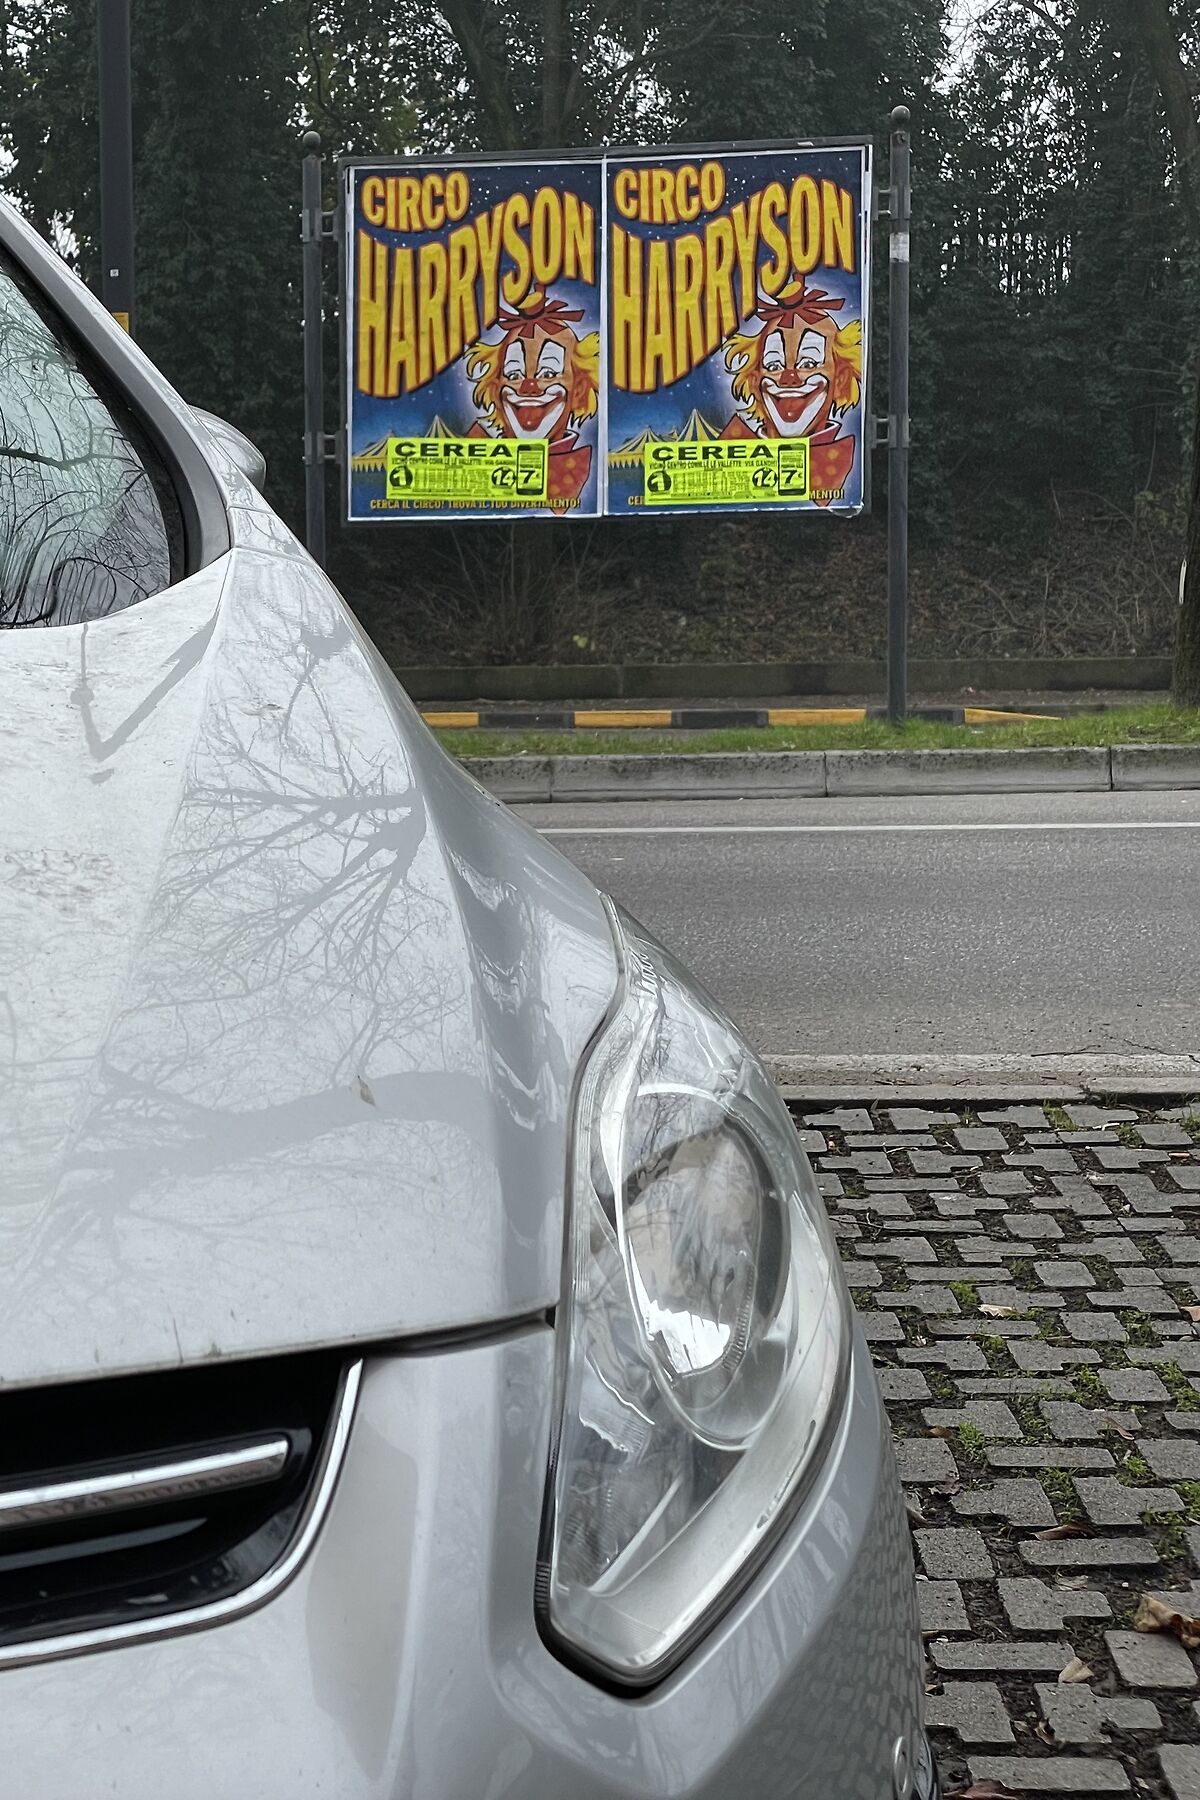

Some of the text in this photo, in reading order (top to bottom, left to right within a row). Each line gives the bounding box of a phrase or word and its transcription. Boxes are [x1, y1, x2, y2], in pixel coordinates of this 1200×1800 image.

[361, 169, 470, 232] CIRCO
[613, 160, 725, 225] CIRCO
[357, 187, 596, 397] HARRYSON
[612, 174, 853, 392] HARRYSON
[395, 442, 513, 458] CEREA
[652, 444, 774, 462] CEREA
[493, 469, 515, 487] 14
[753, 471, 776, 488] 14
[370, 500, 400, 509] CERCA
[403, 500, 410, 509] IL
[413, 500, 444, 509] CIRCO!
[449, 500, 478, 509] TROVA
